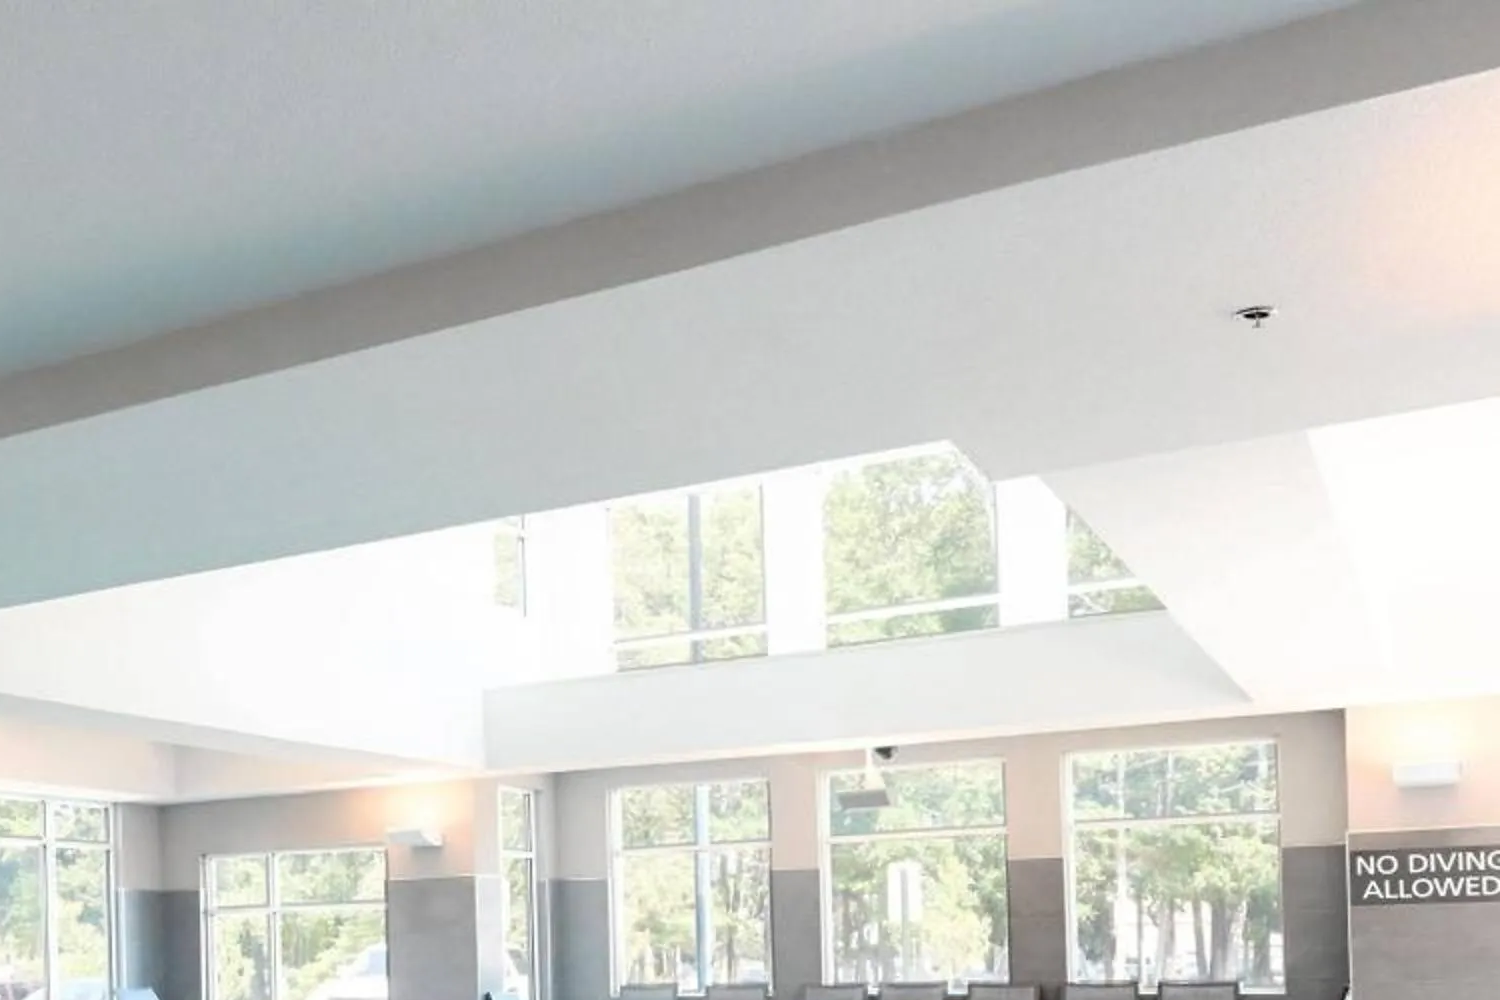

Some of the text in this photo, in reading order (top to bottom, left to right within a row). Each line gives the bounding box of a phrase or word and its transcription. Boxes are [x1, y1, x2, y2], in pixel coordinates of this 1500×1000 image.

[1356, 849, 1500, 876] NO DIVING
[1363, 875, 1500, 899] ALLOWED
